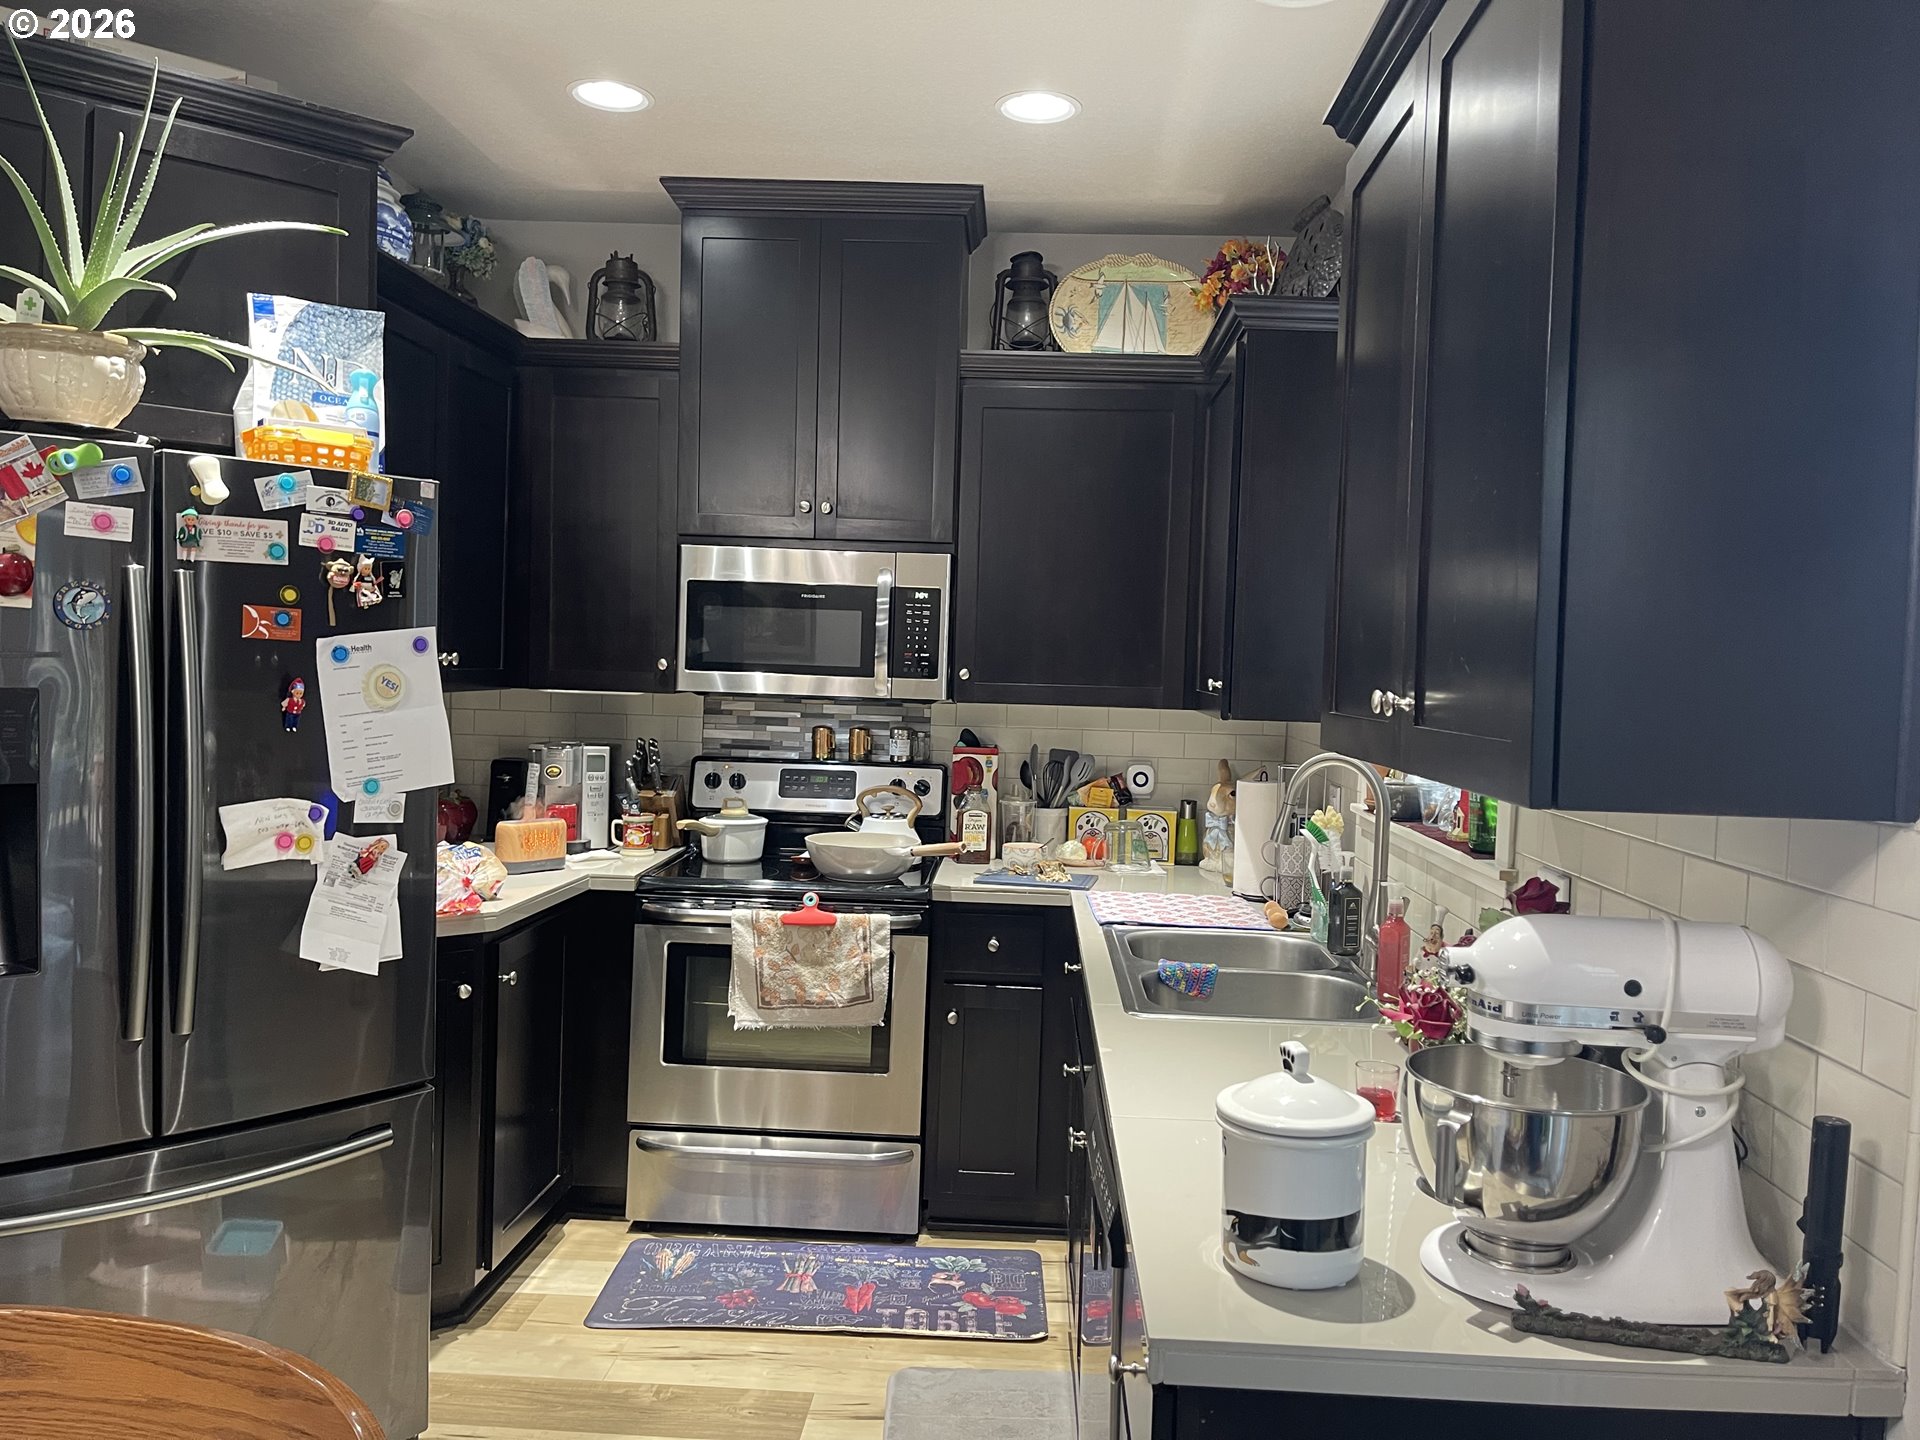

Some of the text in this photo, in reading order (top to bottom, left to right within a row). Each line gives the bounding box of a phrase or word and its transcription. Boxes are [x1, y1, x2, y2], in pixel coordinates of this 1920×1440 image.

[319, 394, 349, 405] OCEA
[217, 528, 232, 536] $10
[56, 579, 107, 602] OREGON
[65, 612, 110, 629] COAST
[350, 644, 372, 653] Health
[381, 676, 399, 692] YES!
[964, 823, 985, 831] RAW
[1471, 998, 1503, 1013] nAid
[1540, 1012, 1561, 1020] Power
